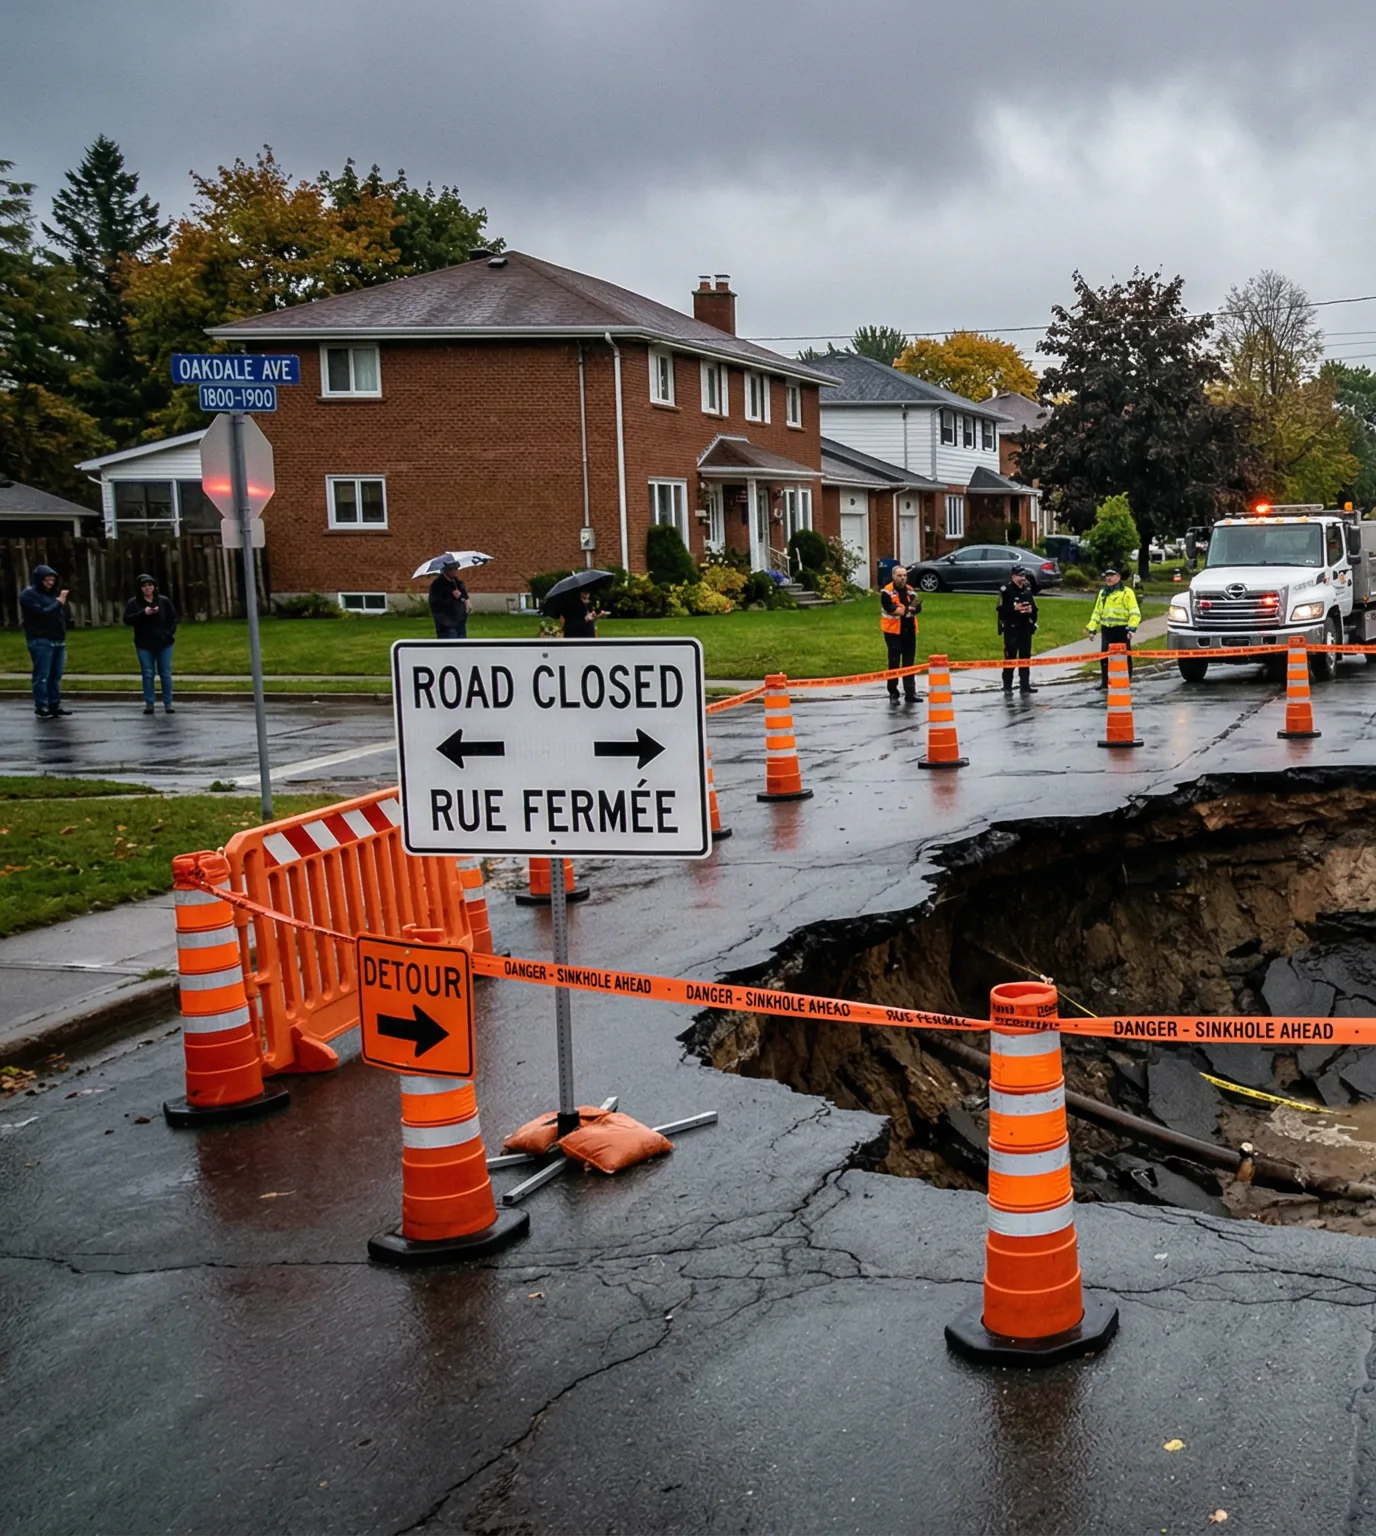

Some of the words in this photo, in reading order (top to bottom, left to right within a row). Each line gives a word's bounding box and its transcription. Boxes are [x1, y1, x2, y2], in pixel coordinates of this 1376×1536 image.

[180, 359, 254, 379] OAKDALE
[262, 360, 292, 380] AVE
[203, 388, 273, 407] 1800-1900
[412, 665, 514, 709] ROAD
[532, 664, 684, 709] CLOSED
[430, 789, 507, 832] RUE
[522, 778, 679, 833] FERMÉE
[363, 955, 462, 999] DETOUR
[557, 968, 611, 989] SINKHOLE
[614, 978, 651, 994] AHEAD
[686, 984, 733, 1004] DANGER
[745, 991, 805, 1012] SINKHOLE
[1113, 1020, 1177, 1037] DANGER
[1195, 1021, 1275, 1039] SINKHOLE
[1279, 1022, 1334, 1040] AHEAD
